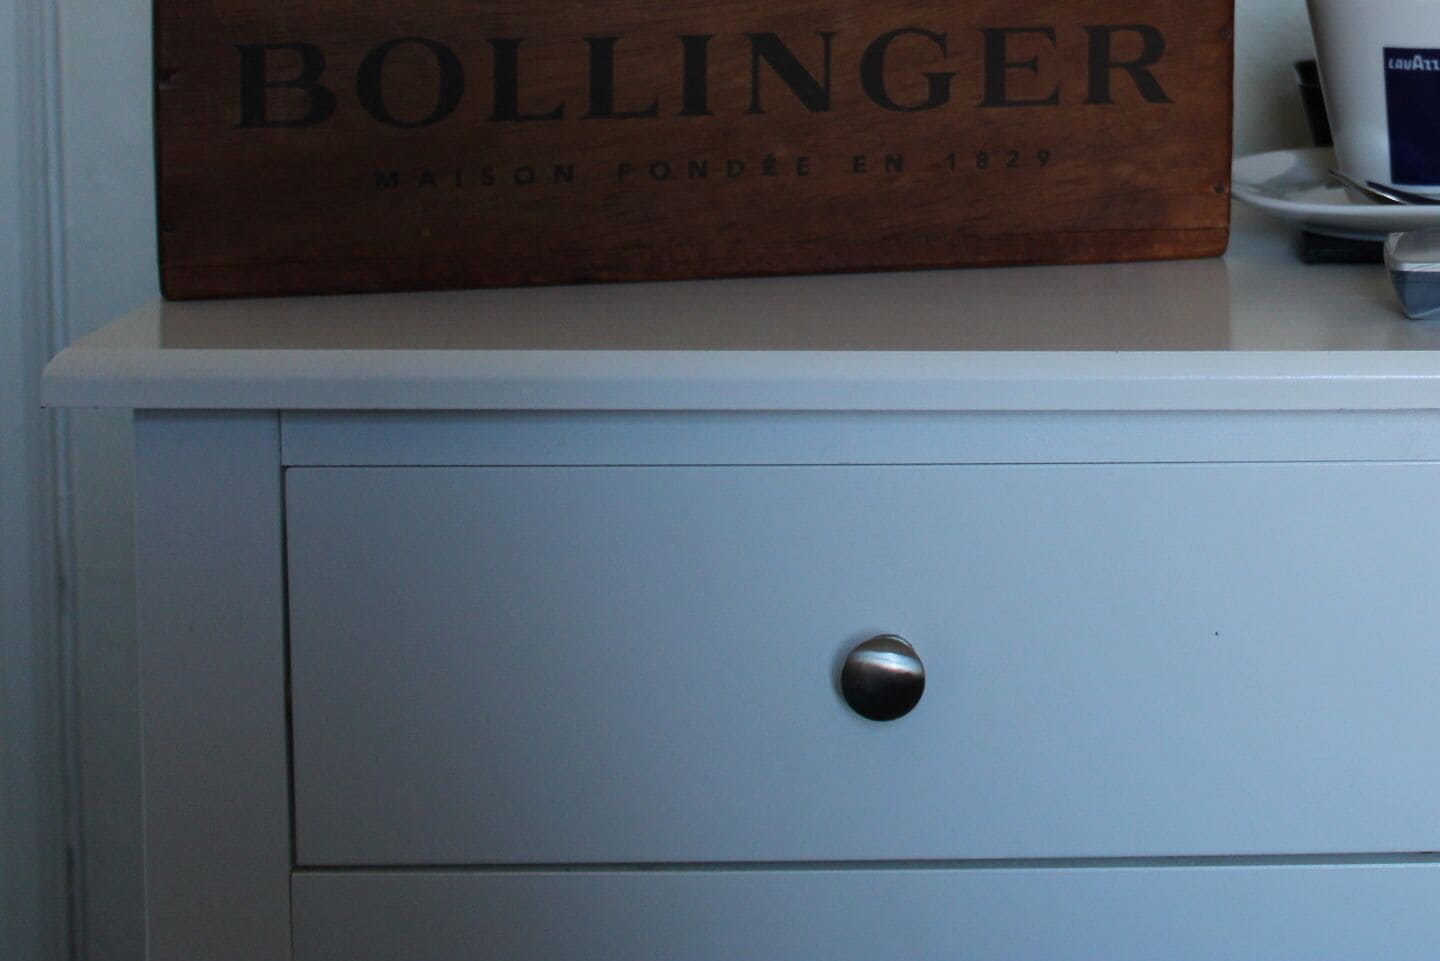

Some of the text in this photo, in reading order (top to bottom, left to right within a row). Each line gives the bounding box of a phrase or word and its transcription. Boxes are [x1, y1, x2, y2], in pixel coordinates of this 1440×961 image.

[231, 23, 1175, 130] BOLLINGER
[375, 148, 1052, 190] MAISON FONDÉE EN 1829
